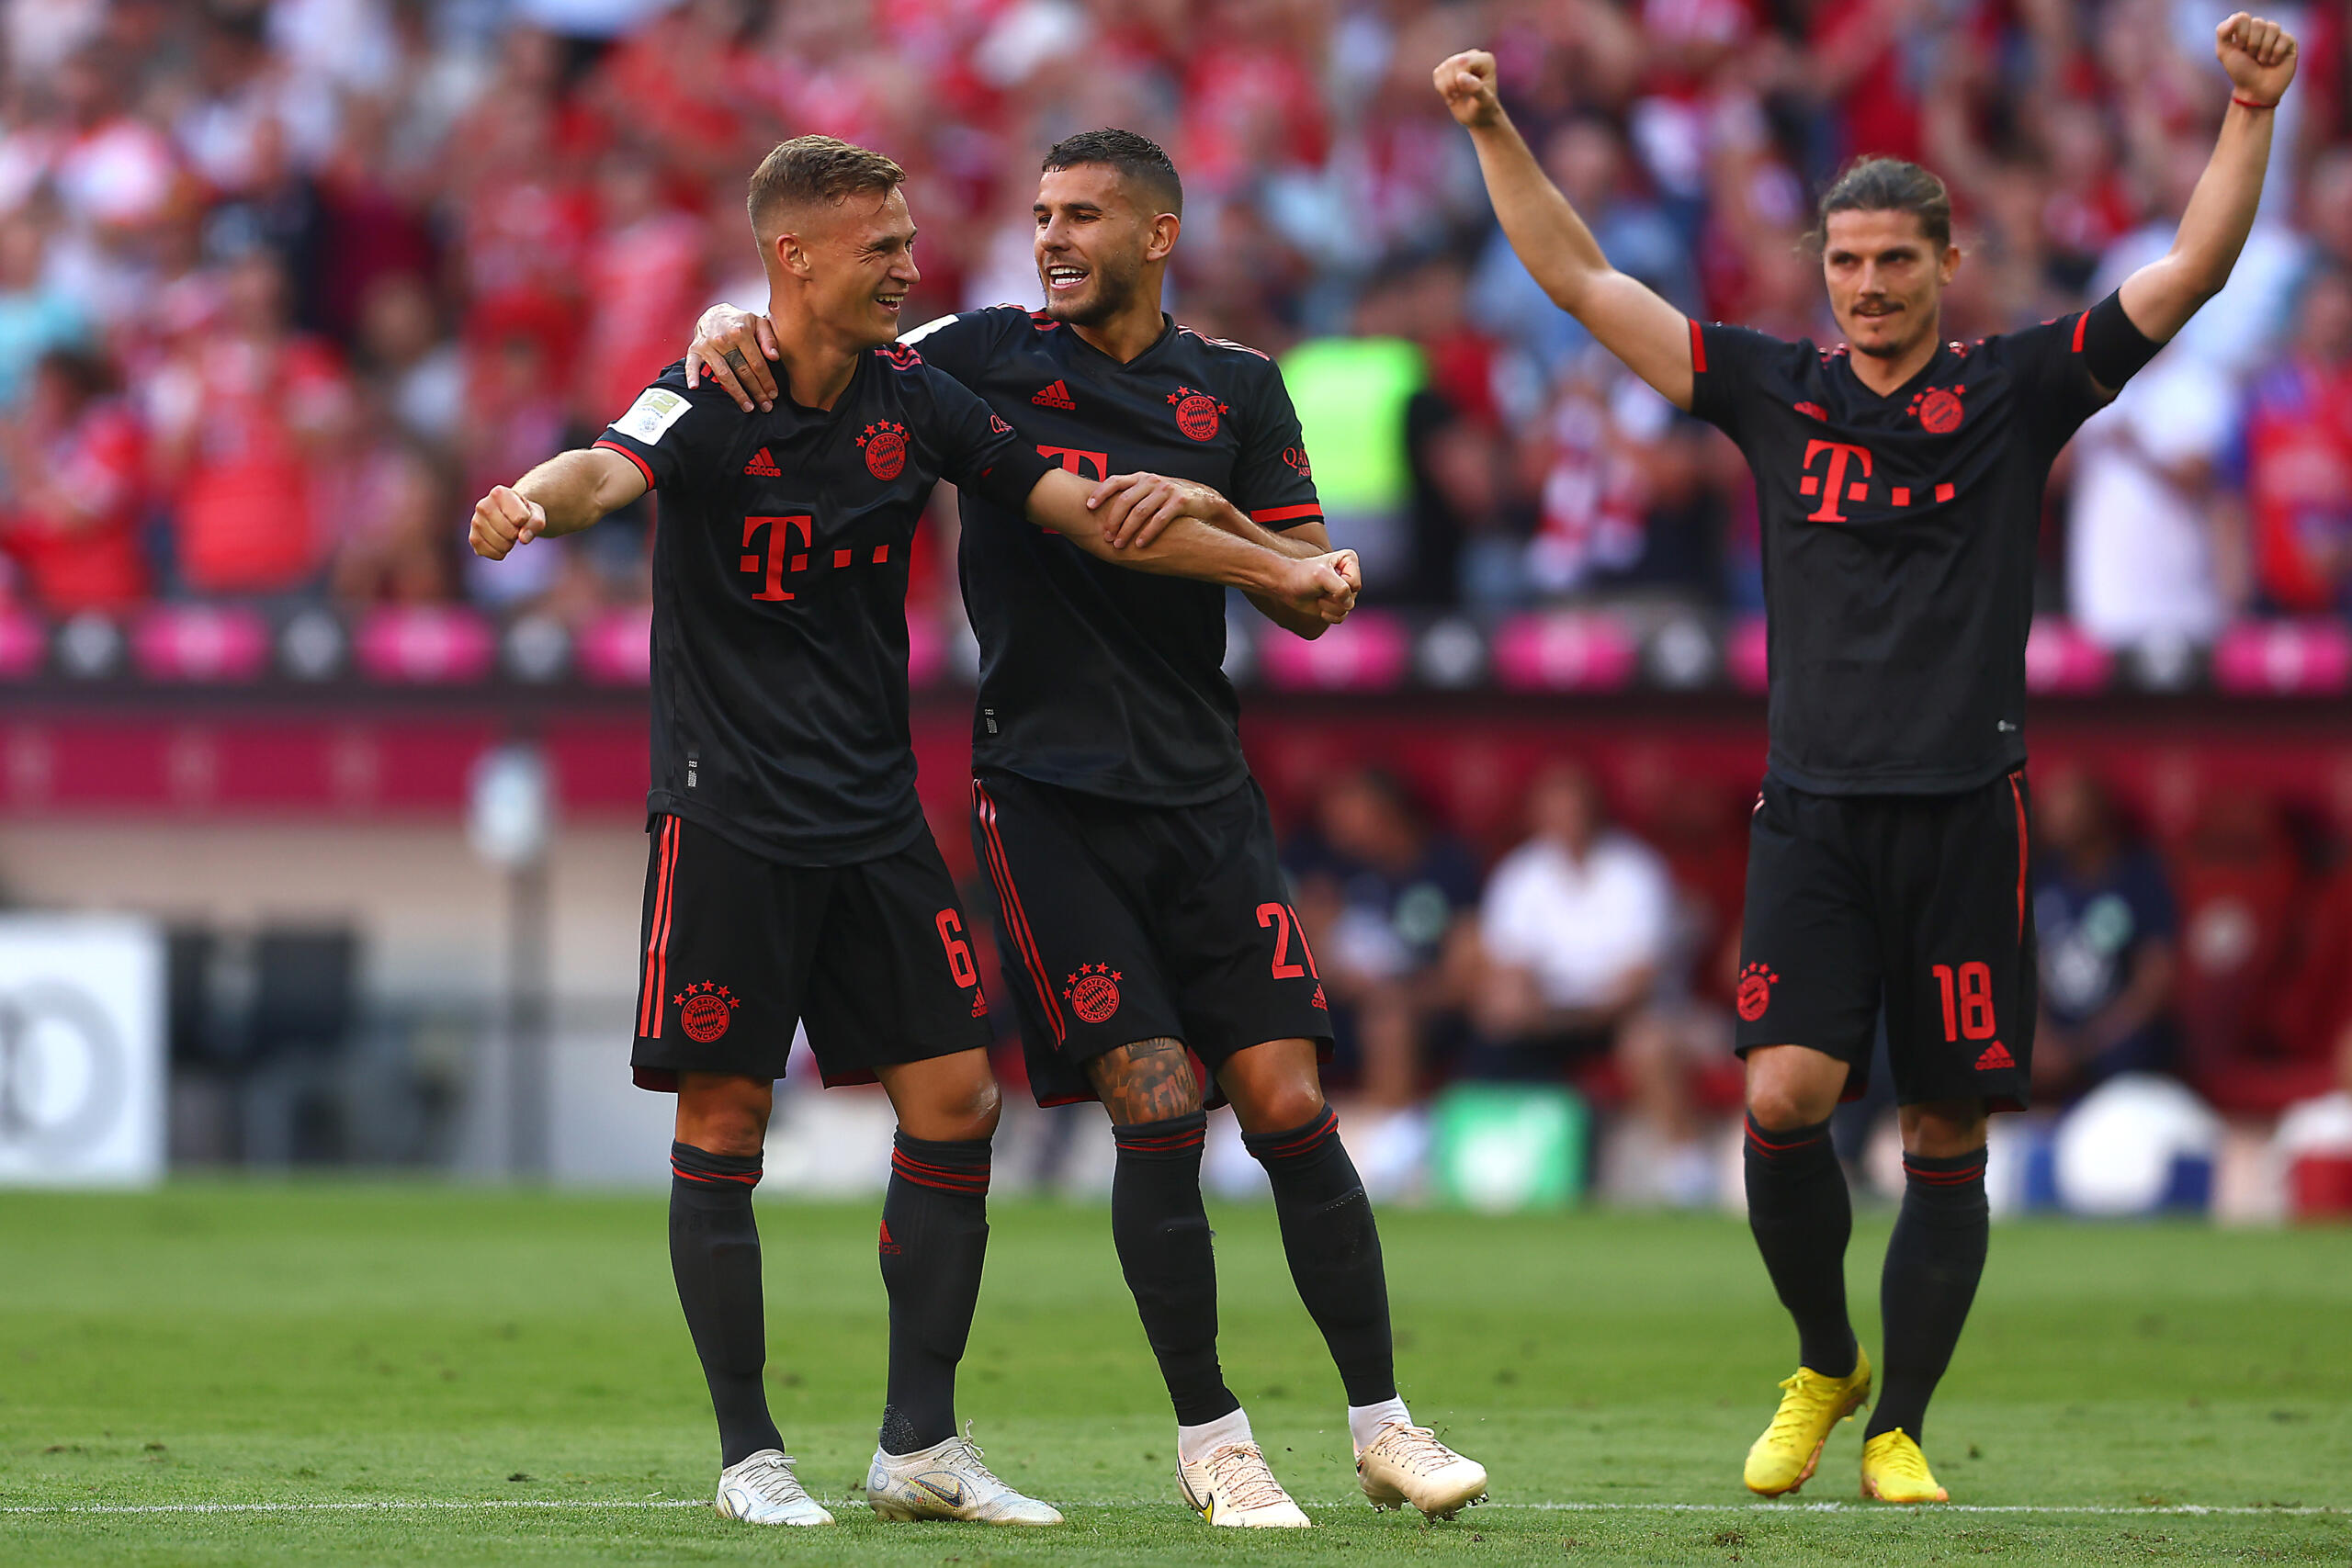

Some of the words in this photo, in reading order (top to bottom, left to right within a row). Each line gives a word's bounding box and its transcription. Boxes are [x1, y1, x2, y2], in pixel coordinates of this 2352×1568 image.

[1031, 396, 1076, 411] adidas
[743, 464, 782, 477] adidas
[1799, 438, 1872, 523] T
[740, 515, 811, 601] T
[935, 908, 977, 988] 6
[1932, 961, 1996, 1042] 18
